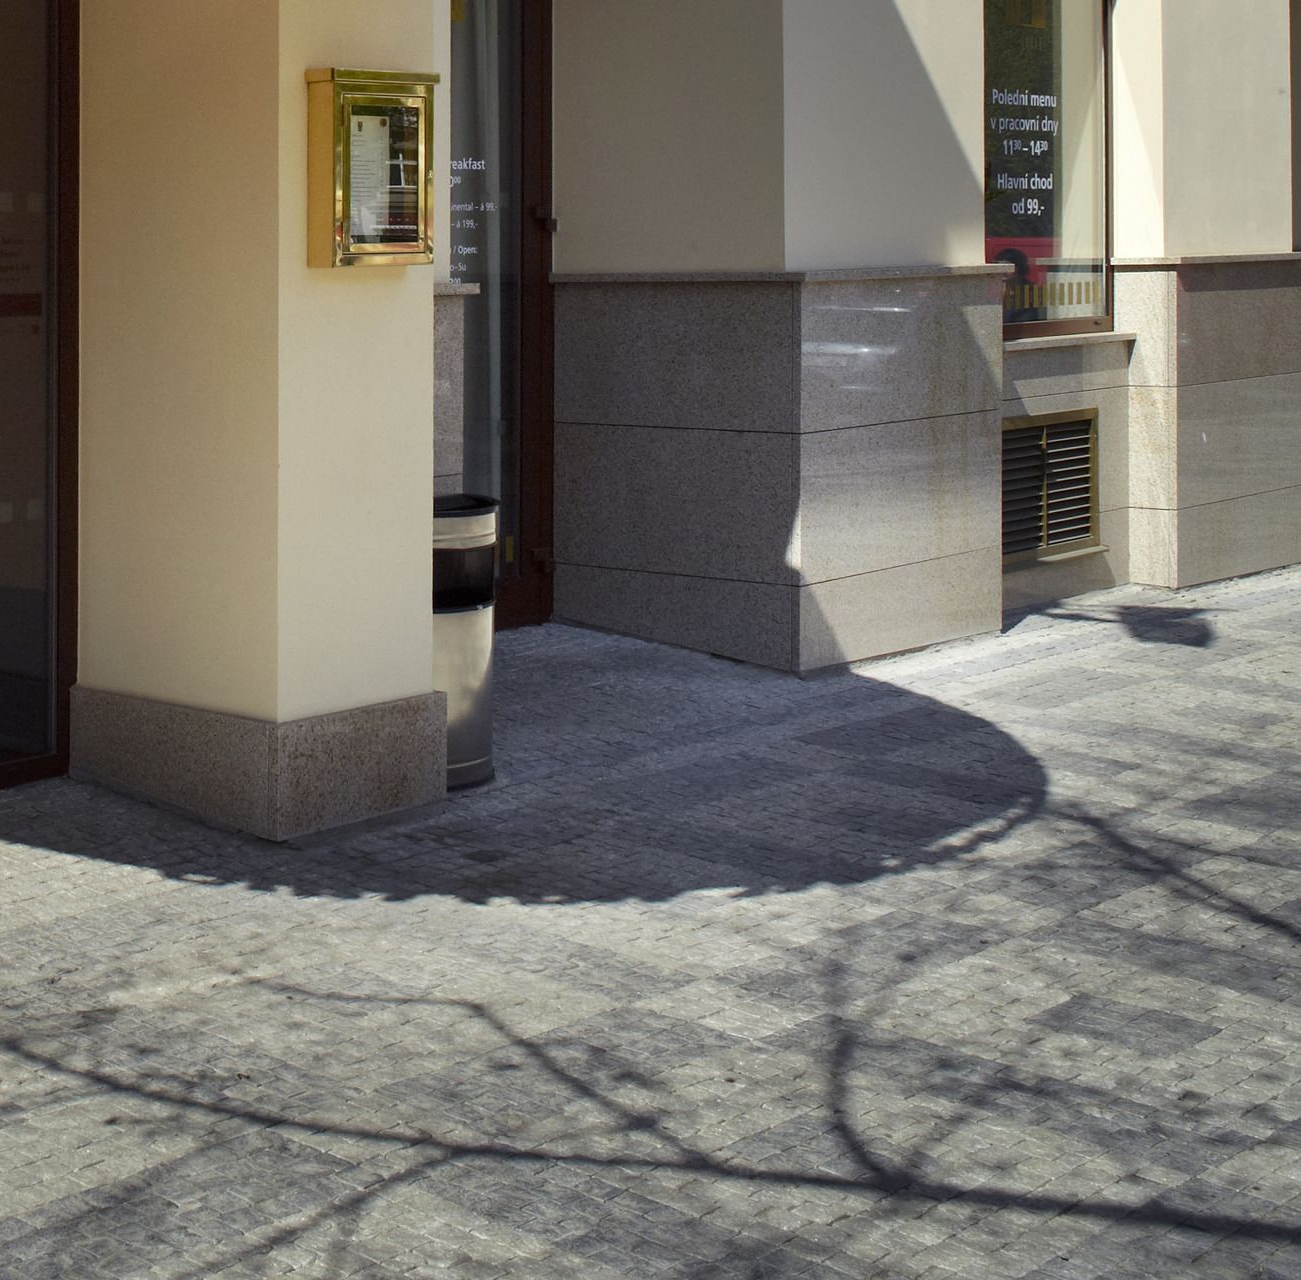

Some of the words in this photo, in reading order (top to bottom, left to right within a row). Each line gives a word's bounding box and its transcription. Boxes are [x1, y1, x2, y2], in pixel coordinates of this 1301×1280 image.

[992, 89, 1028, 106] Polední
[1030, 95, 1057, 107] menu
[990, 118, 996, 129] v
[999, 116, 1039, 133] pracovní
[1041, 116, 1058, 136] dny
[997, 173, 1028, 189] Hlavní
[1030, 173, 1053, 189] chod
[1012, 198, 1024, 214] od
[457, 245, 478, 256] Open:
